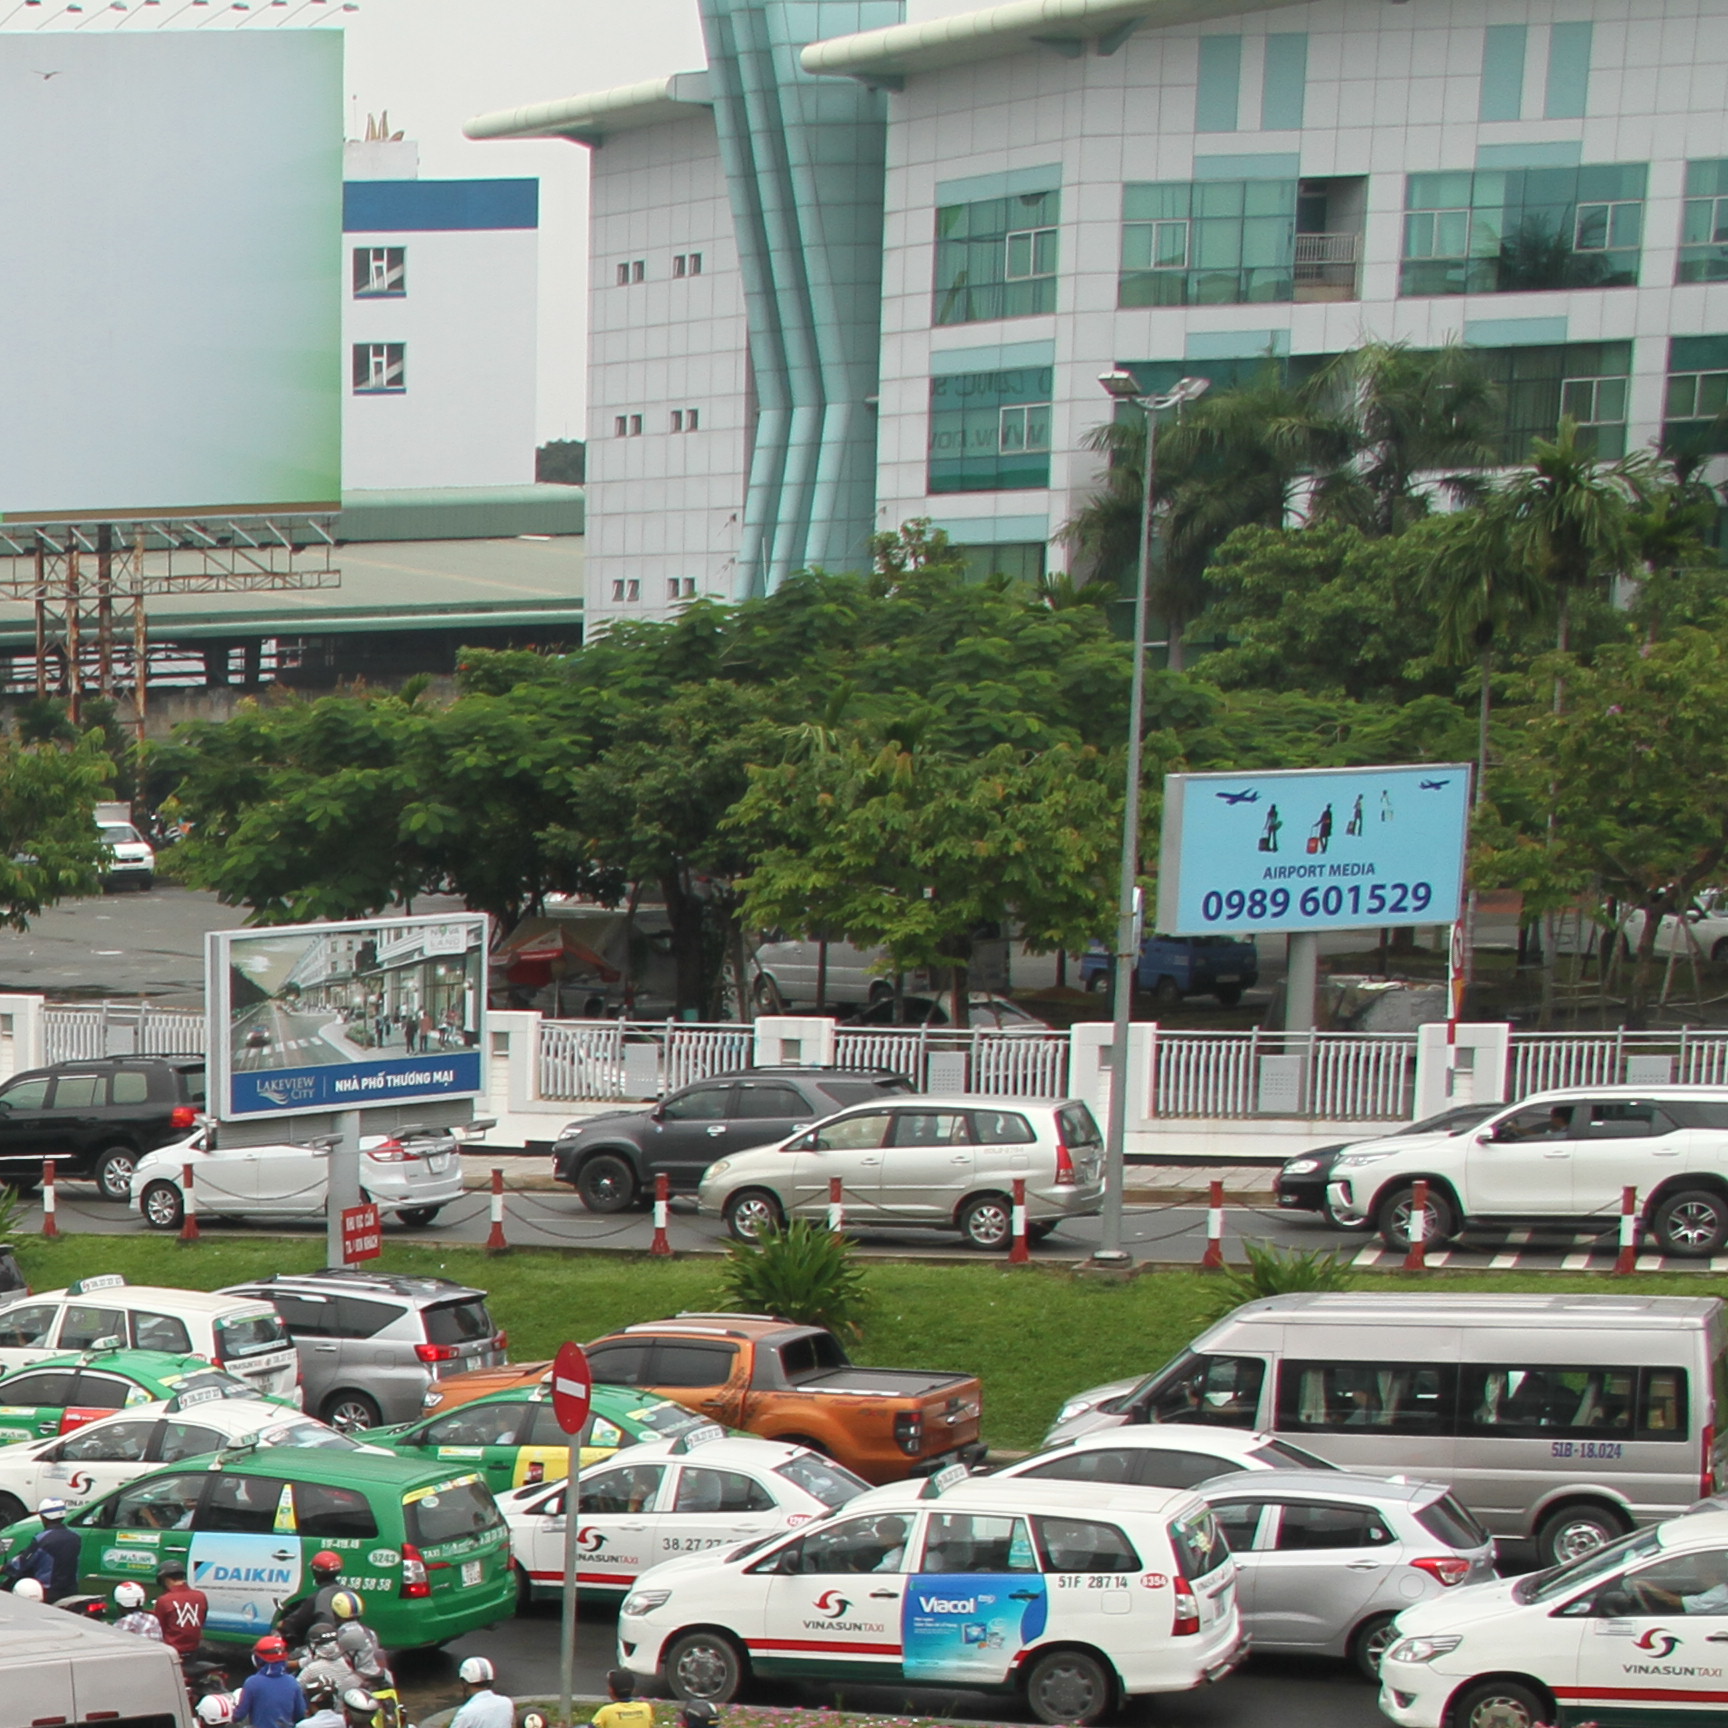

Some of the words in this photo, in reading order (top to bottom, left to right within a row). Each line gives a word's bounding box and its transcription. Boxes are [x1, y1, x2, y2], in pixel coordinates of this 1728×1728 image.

[1263, 864, 1326, 880] AIRPORT
[1329, 862, 1376, 877] MEDIA
[1201, 887, 1290, 922] 0989
[1299, 881, 1432, 919] 601529
[256, 1076, 315, 1093] LAKEVIEW
[335, 1076, 359, 1093] NHÀ
[385, 1072, 431, 1090] THƯƠNG
[433, 1069, 453, 1088] MẠI
[290, 1088, 315, 1101] CITY
[662, 1537, 701, 1552] 38.27
[213, 1567, 291, 1583] DAIKIN
[1057, 1577, 1082, 1588] 51F
[918, 1596, 975, 1614] Viacol
[802, 1619, 885, 1633] VINASUNTAXI
[1622, 1663, 1723, 1678] VINASUNTAXI
